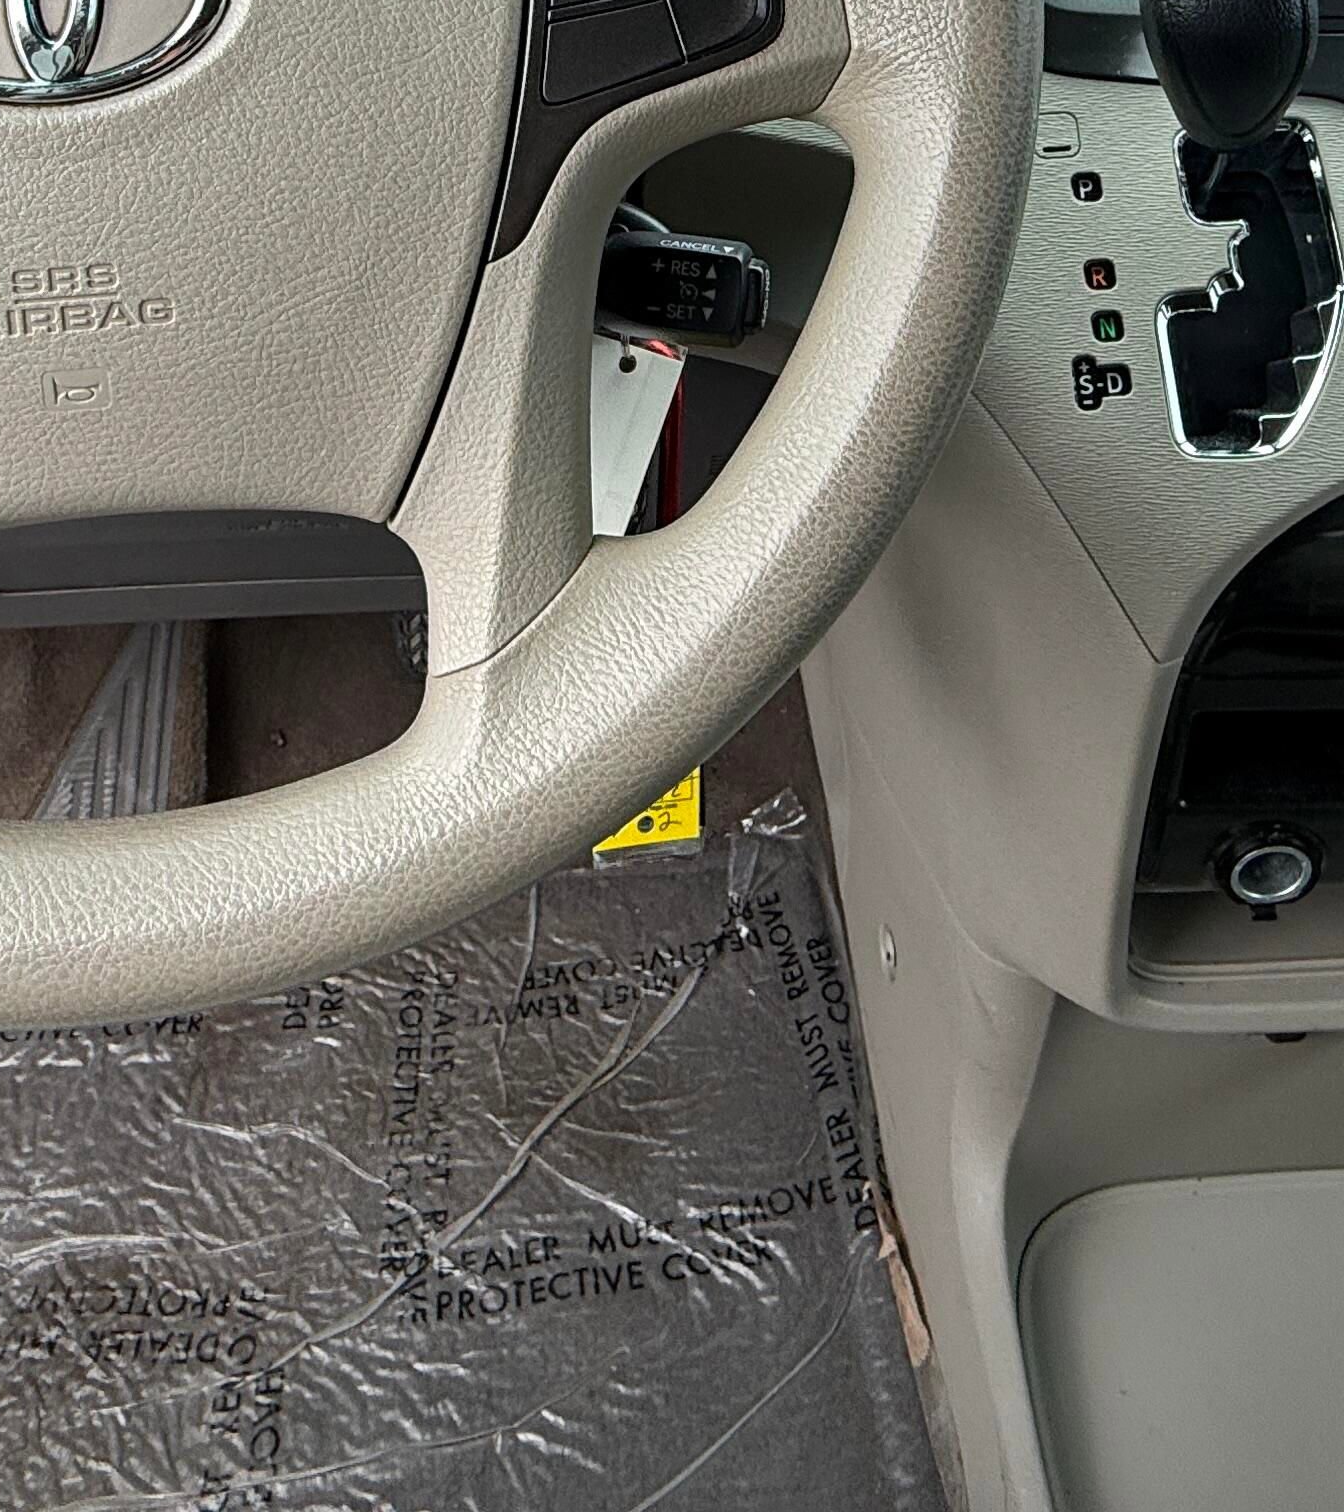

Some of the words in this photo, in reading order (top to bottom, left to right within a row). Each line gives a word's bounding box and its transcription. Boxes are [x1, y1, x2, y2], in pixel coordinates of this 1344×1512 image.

[1078, 179, 1093, 199] P
[659, 239, 721, 253] CANCEL
[11, 263, 121, 294] SRS
[670, 259, 701, 278] RES
[1091, 266, 1107, 287] R
[666, 303, 697, 320] SET
[1099, 317, 1116, 338] N
[756, 891, 810, 1001] REMOVE
[806, 937, 852, 1025] COVER
[387, 969, 427, 1149] PROTECTIVE
[794, 1013, 840, 1093] MUST
[825, 1107, 879, 1232] DEALER
[699, 1176, 838, 1234] REMOVE
[436, 1260, 646, 1322] PROTECTIVE
